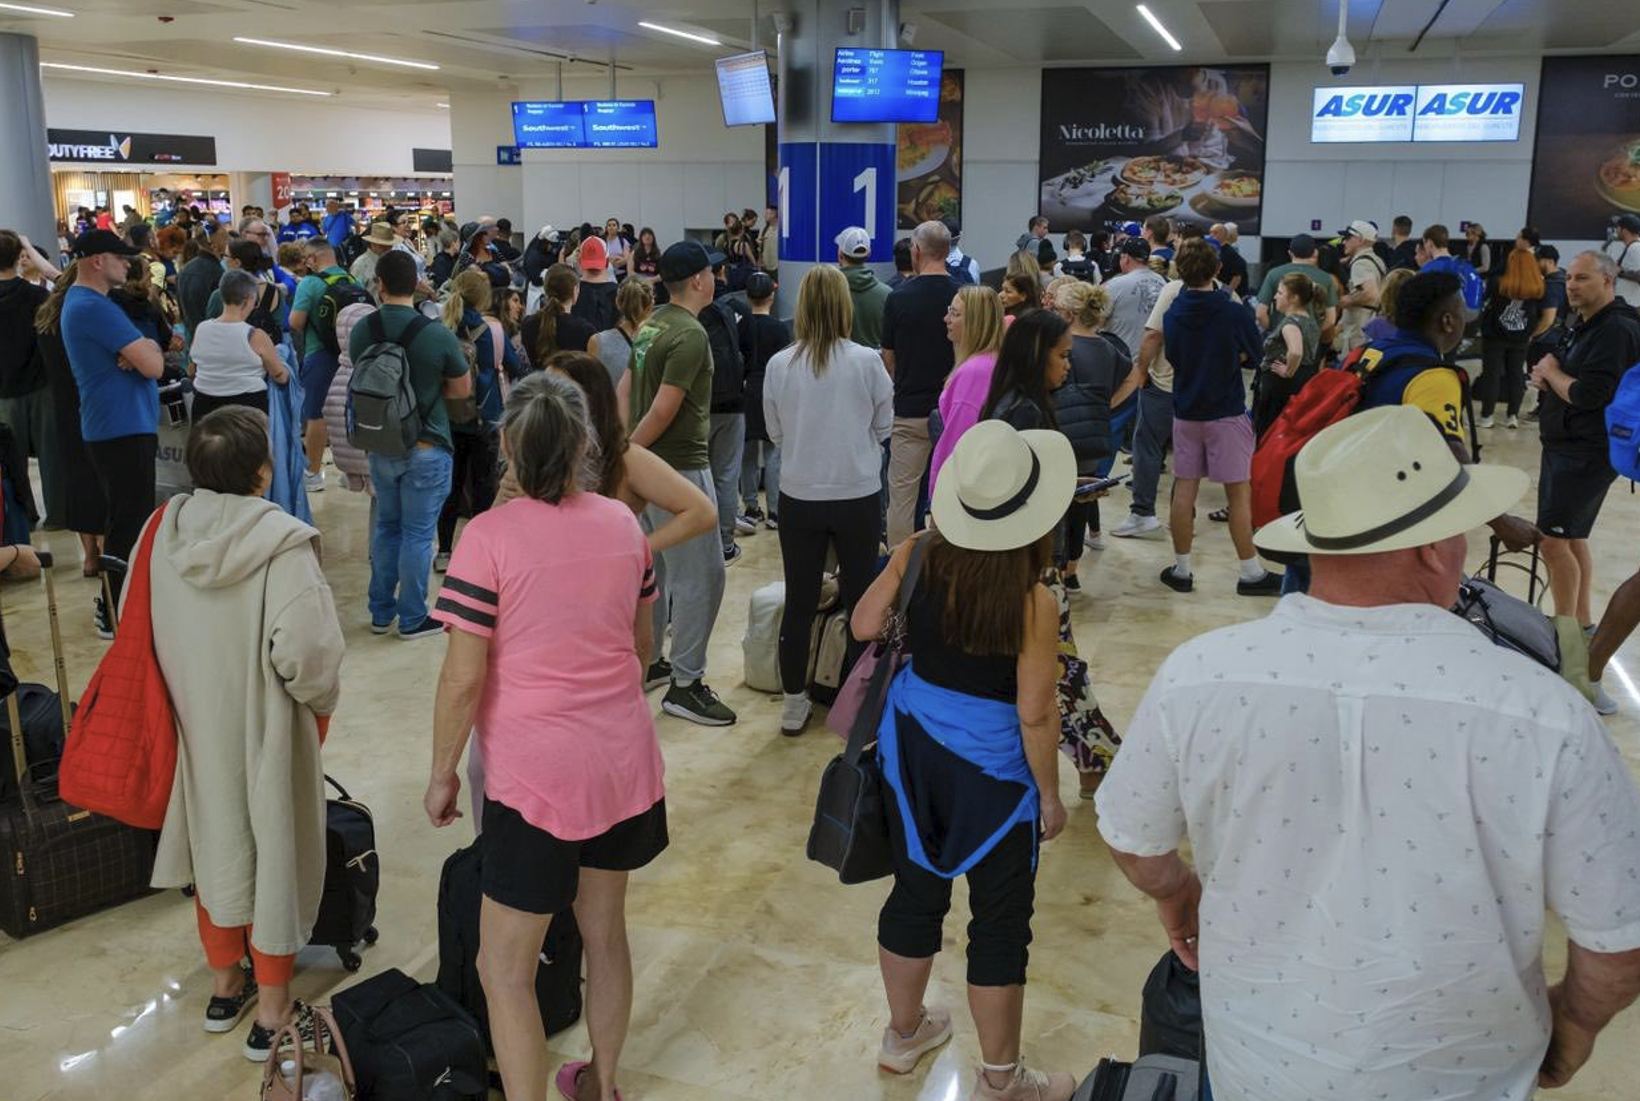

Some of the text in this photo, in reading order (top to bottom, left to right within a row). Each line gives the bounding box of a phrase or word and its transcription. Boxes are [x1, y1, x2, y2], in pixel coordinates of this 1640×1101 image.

[514, 104, 519, 114] 1
[584, 103, 589, 113] 1
[1315, 93, 1413, 117] ASUR
[1417, 91, 1521, 116] ASUR
[522, 124, 569, 132] Southwest
[1059, 123, 1144, 139] Nicoletta
[778, 166, 790, 238] 1
[853, 167, 877, 240] 1
